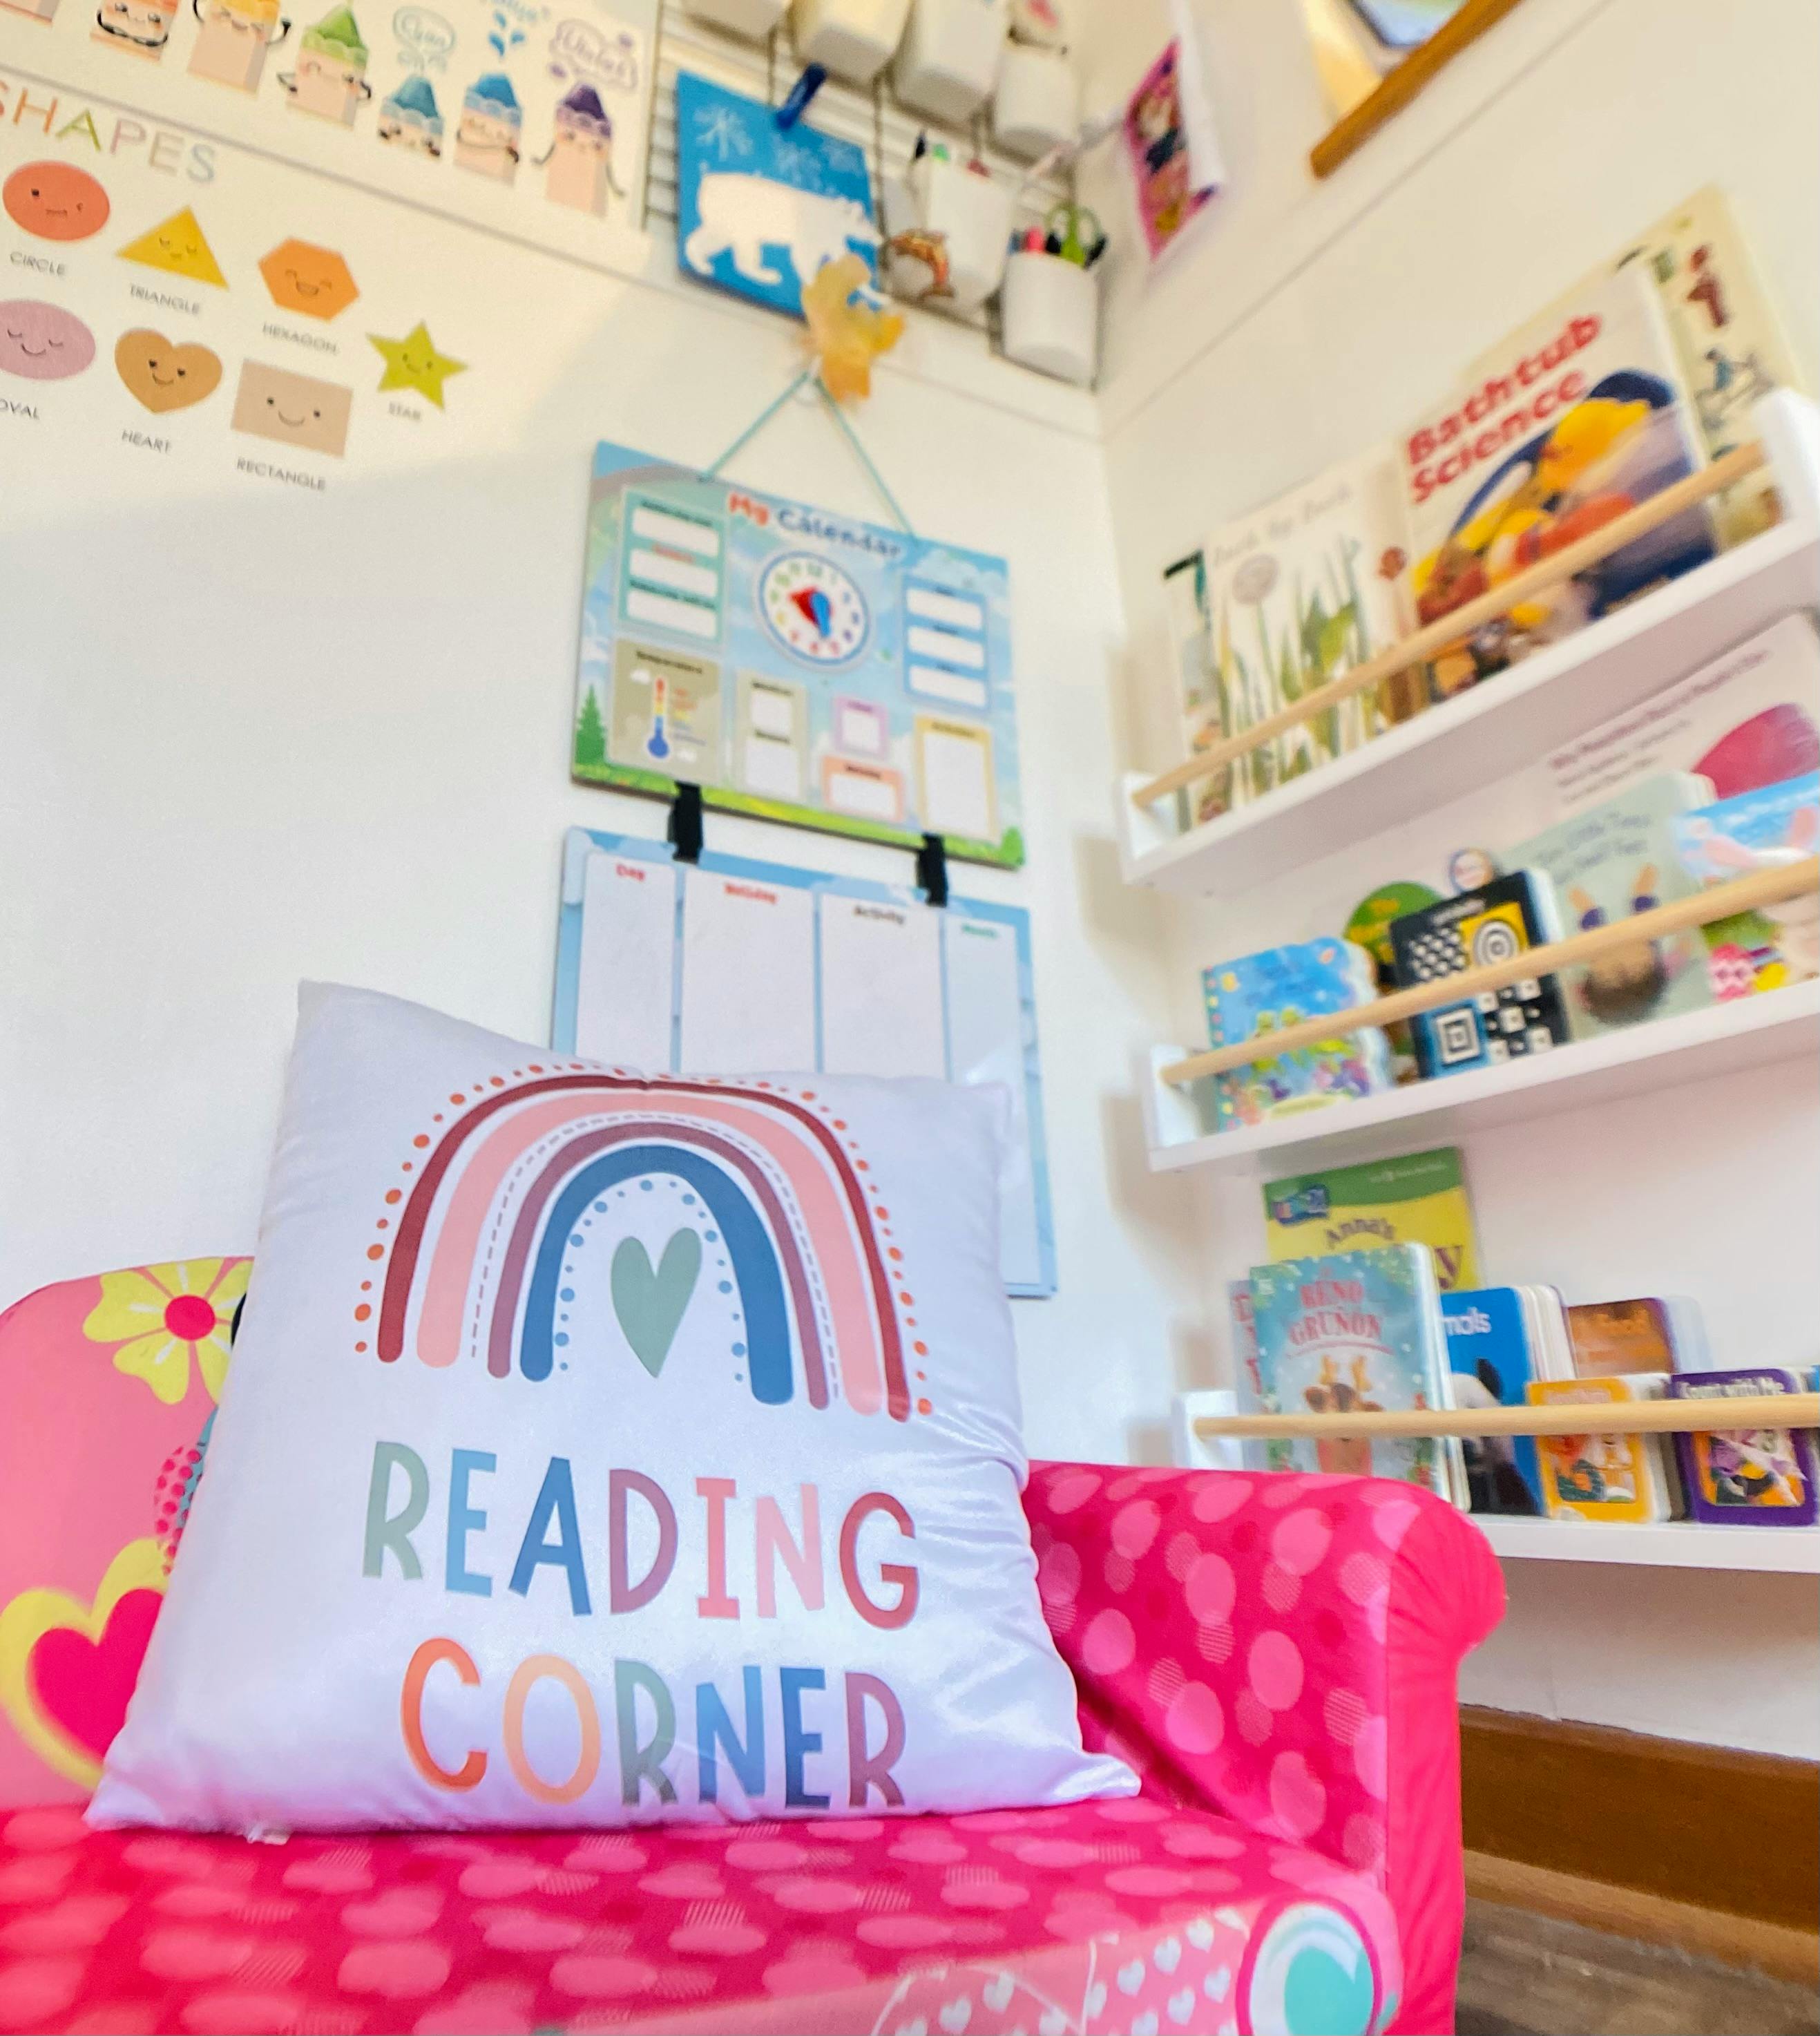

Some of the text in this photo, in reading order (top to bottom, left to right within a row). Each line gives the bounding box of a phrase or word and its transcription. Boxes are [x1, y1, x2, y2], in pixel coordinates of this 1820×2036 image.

[10, 251, 66, 277] CIRCLE
[130, 283, 200, 315] TRIANGLE
[262, 323, 338, 354] HEXAGON
[1408, 314, 1602, 465] Bathtub
[388, 402, 421, 421] STAR
[122, 429, 172, 455] HEART
[1412, 370, 1584, 504] Science
[236, 457, 327, 492] RECTANGLE
[729, 491, 769, 527] My
[778, 507, 901, 558] Calendar
[615, 864, 646, 882] Day
[854, 898, 905, 924] Activity
[1325, 1217, 1395, 1250] Anna's
[1300, 1279, 1364, 1309] RENO
[363, 1441, 920, 1630] READING
[401, 1638, 907, 1809] CORNER
